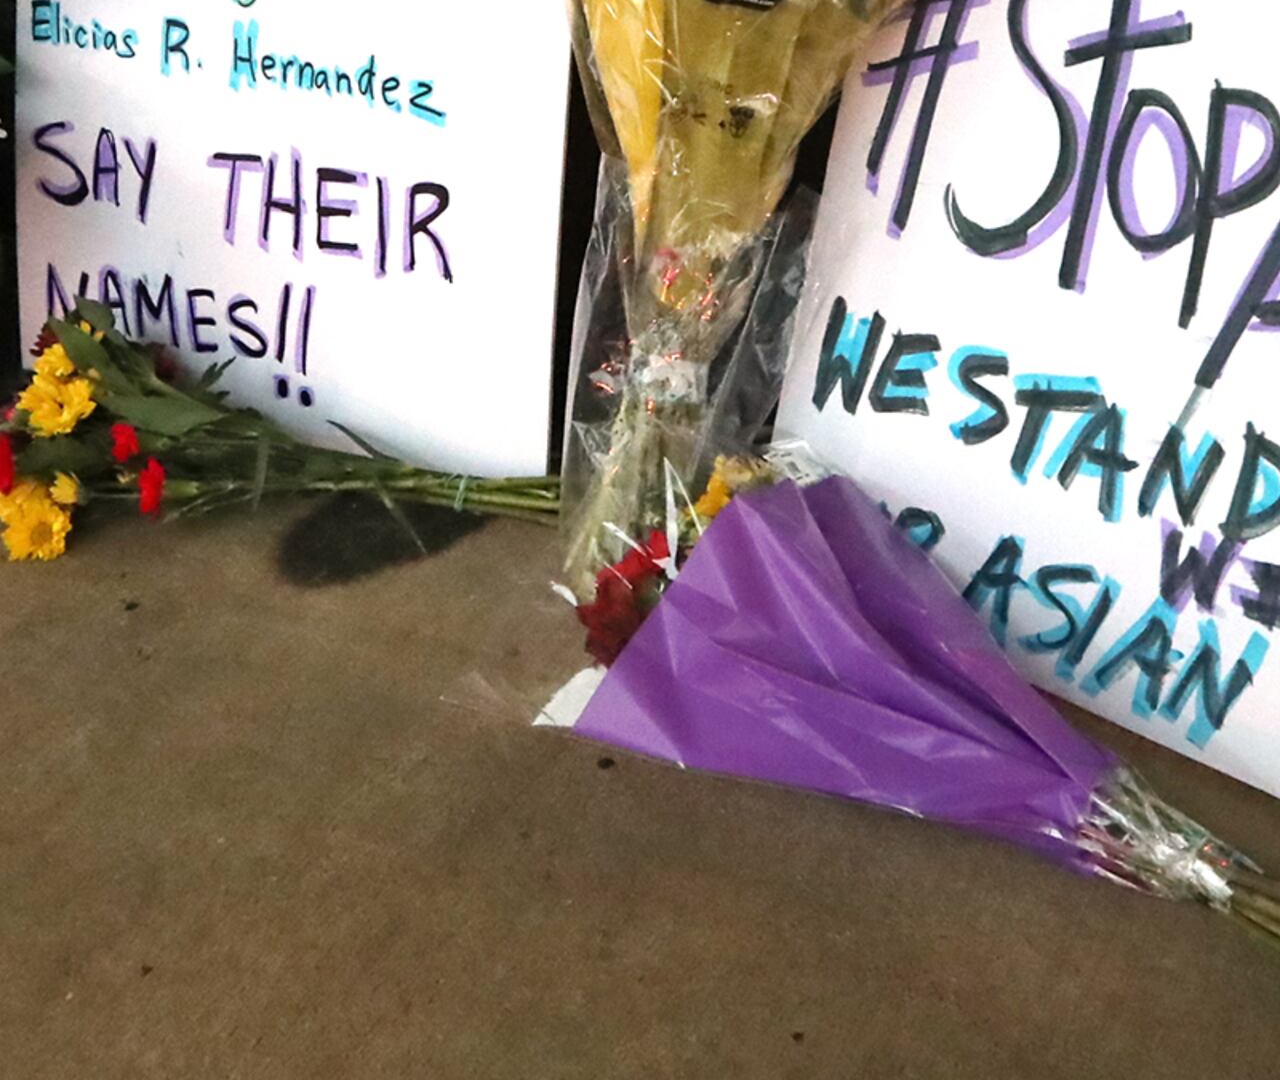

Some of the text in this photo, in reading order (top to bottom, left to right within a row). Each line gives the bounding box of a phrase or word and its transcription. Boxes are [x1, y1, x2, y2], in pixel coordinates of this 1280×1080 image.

[227, 18, 446, 128] Hernandez
[33, 120, 454, 284] SAY THEIR
[961, 534, 1270, 750] ASIAN
